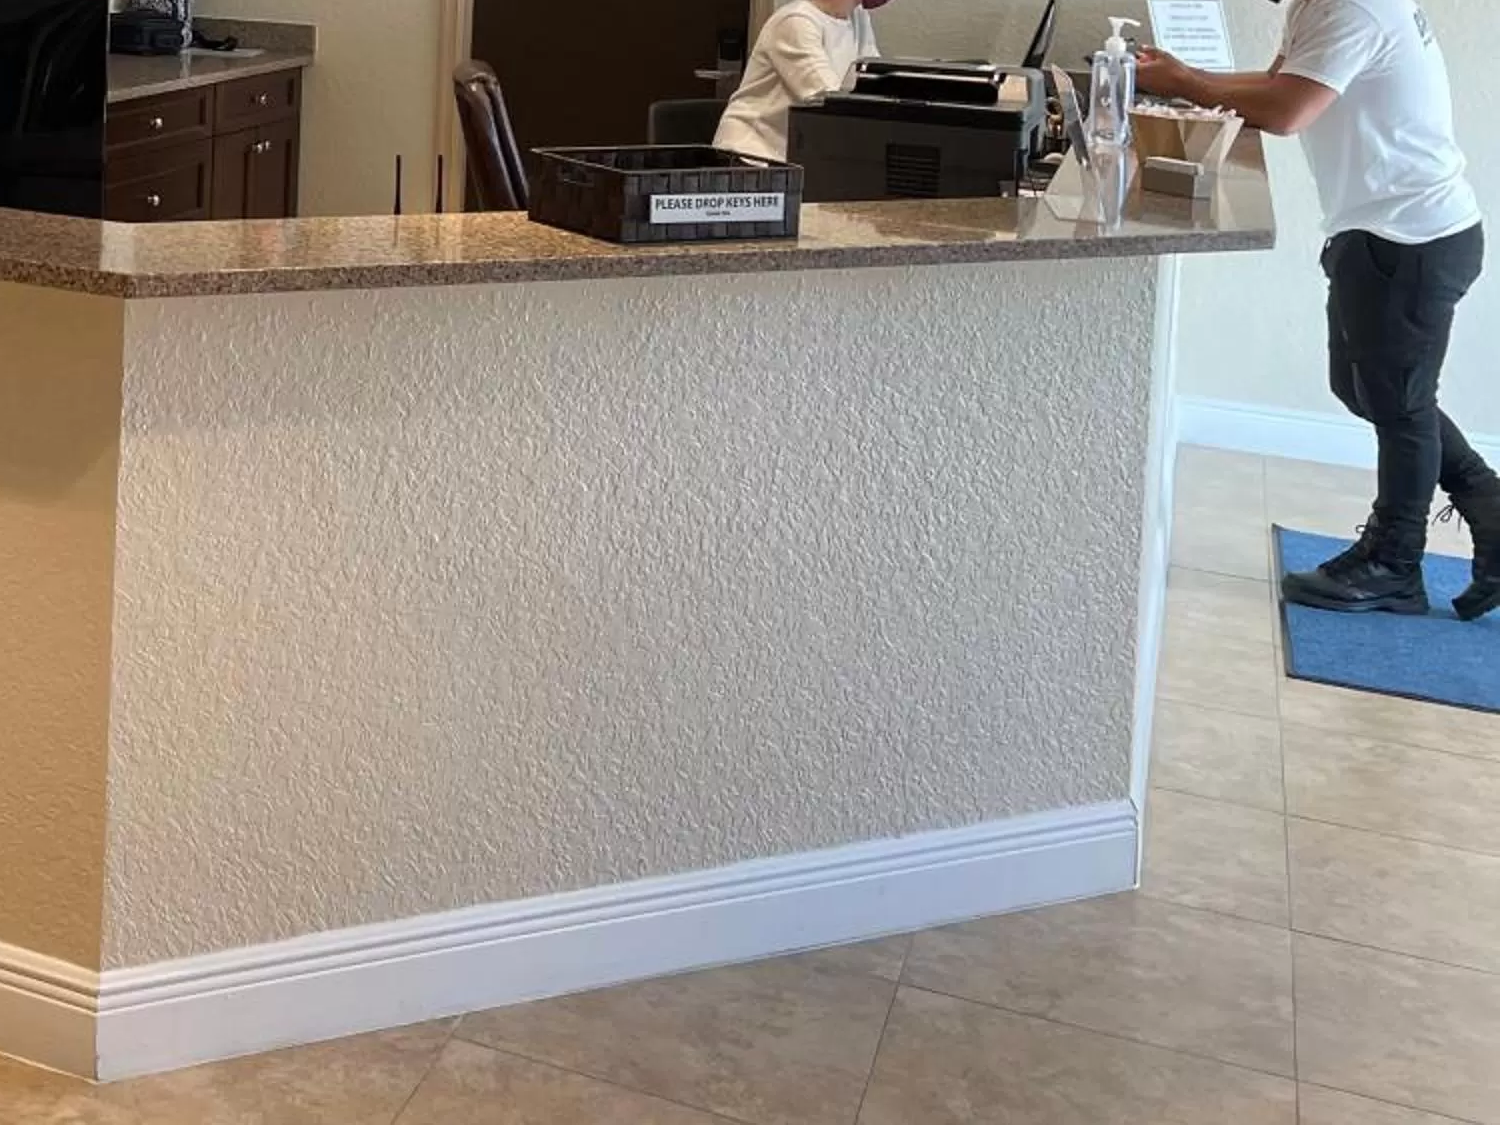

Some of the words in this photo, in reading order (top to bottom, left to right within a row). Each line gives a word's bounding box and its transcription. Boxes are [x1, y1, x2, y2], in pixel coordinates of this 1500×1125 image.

[655, 197, 693, 210] PLEASE
[695, 196, 725, 210] DROP
[725, 195, 751, 208] KEYS
[753, 195, 779, 208] HERE
